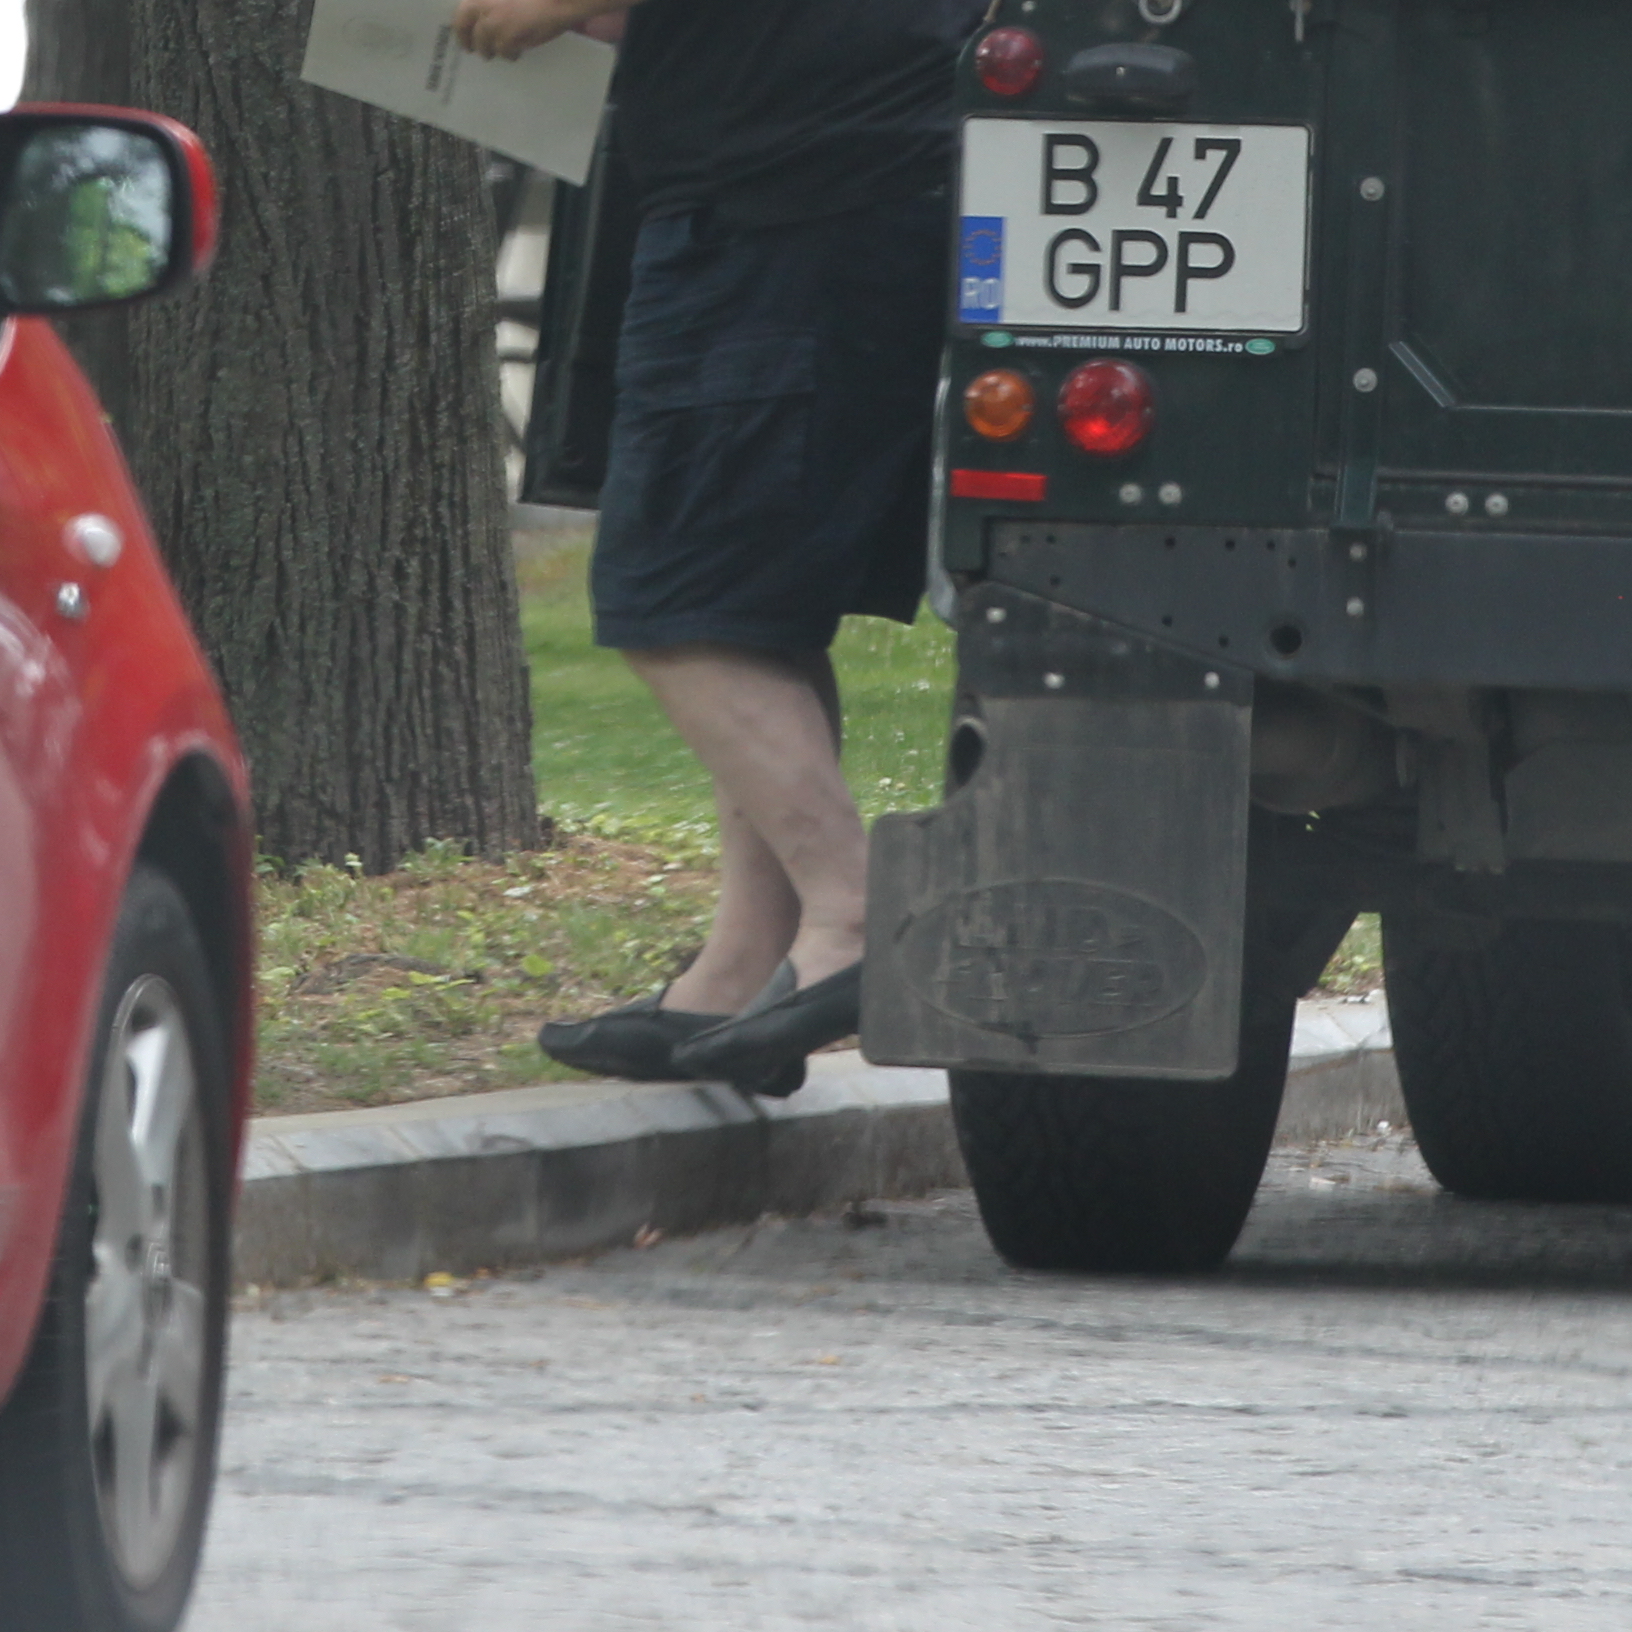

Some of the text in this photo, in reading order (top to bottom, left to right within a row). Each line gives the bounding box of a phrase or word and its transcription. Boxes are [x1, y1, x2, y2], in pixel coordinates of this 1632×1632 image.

[1040, 132, 1242, 219] B 47
[1043, 227, 1235, 313] GPP
[1123, 337, 1161, 351] AUTO
[1164, 337, 1244, 353] MOTORS.ro
